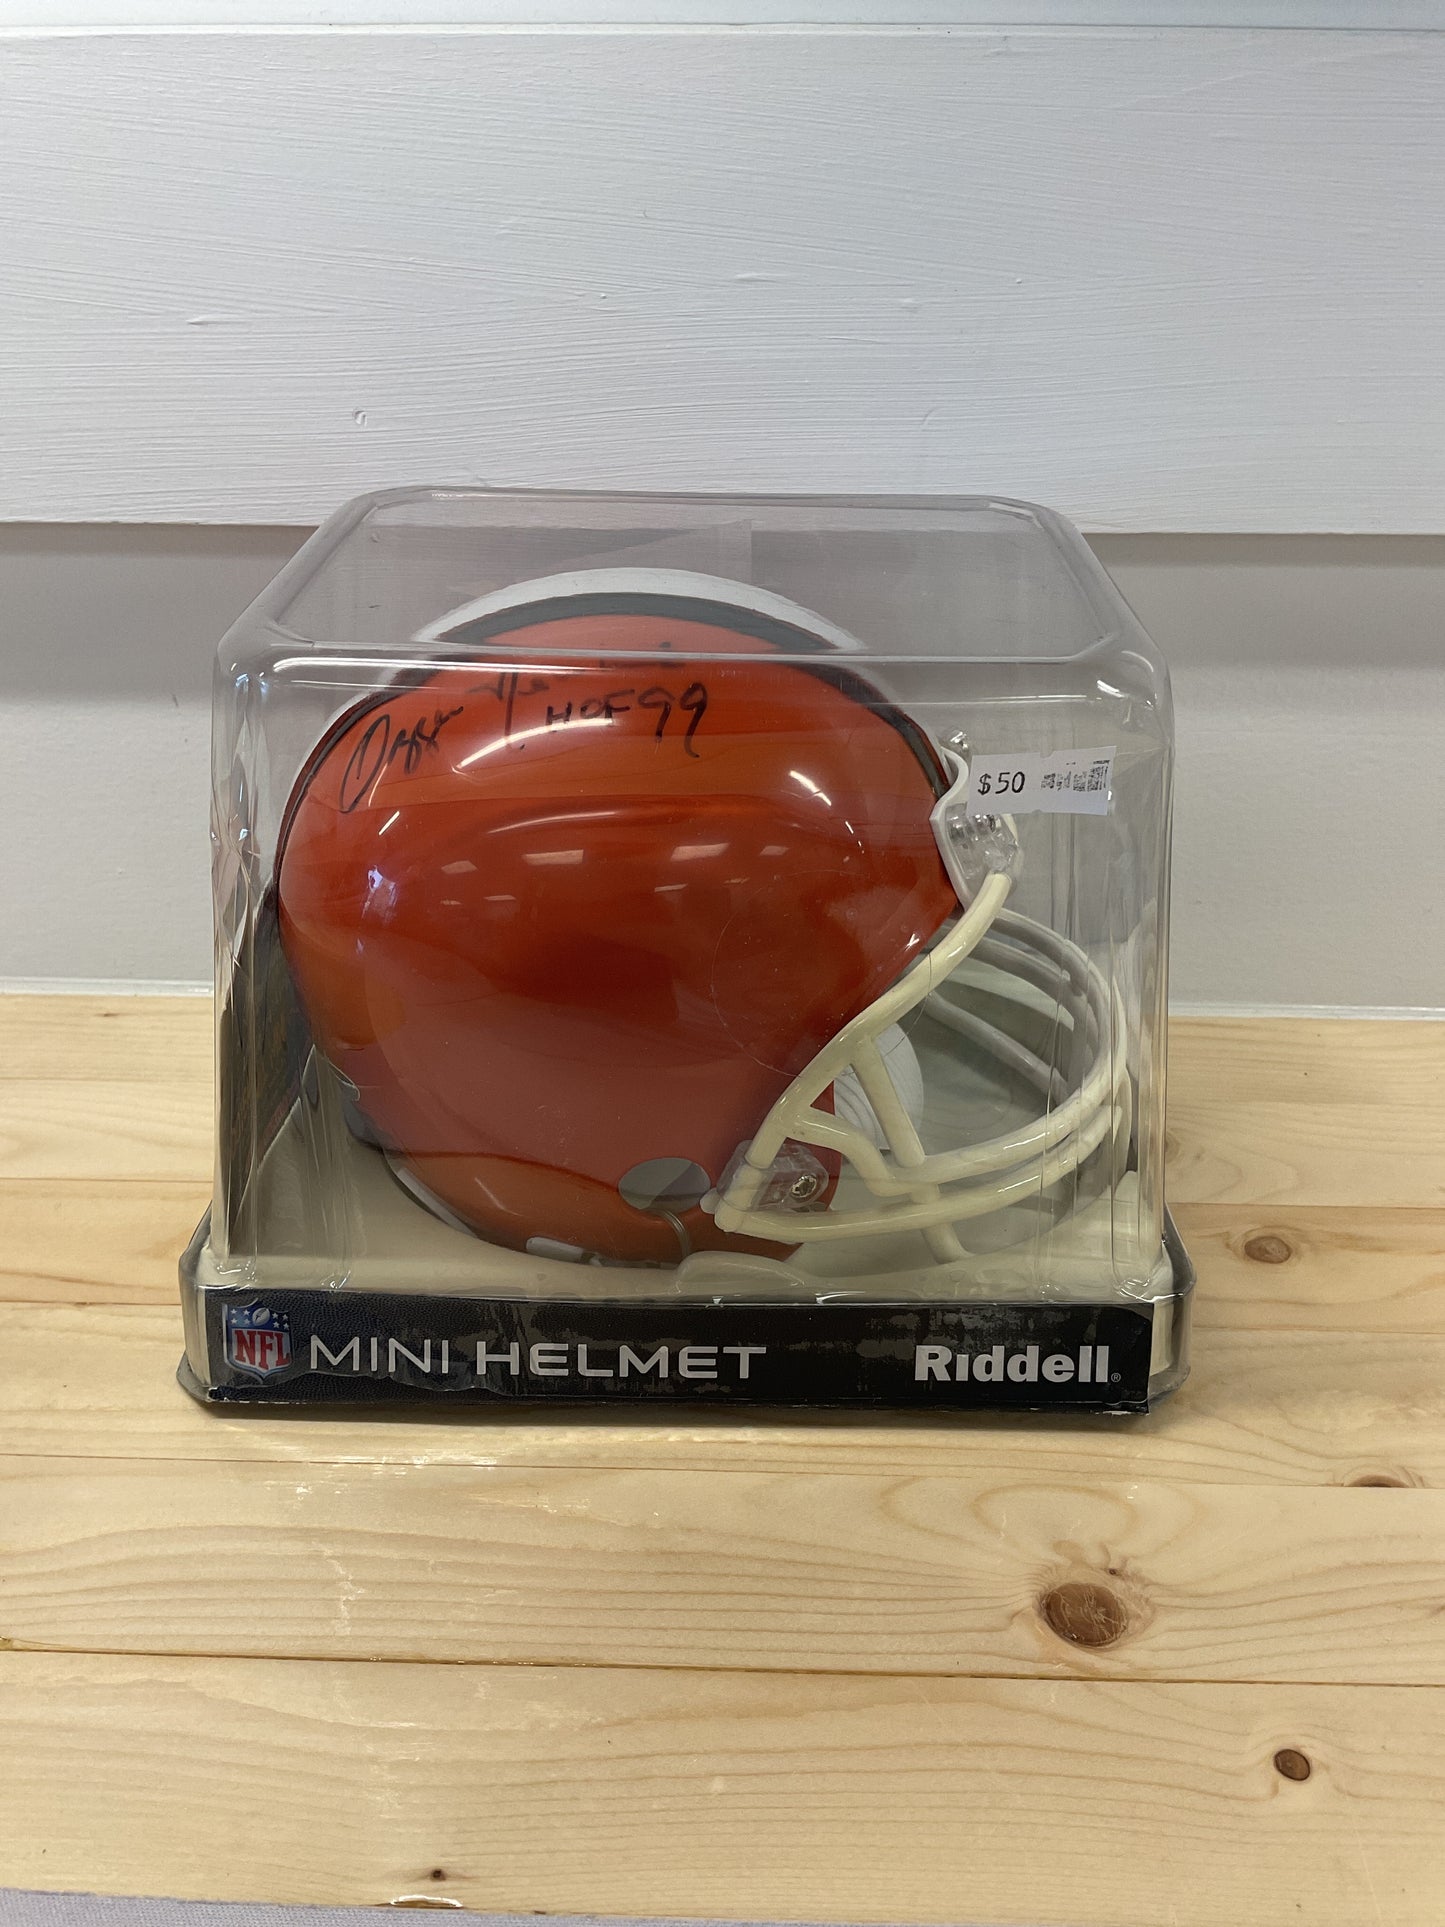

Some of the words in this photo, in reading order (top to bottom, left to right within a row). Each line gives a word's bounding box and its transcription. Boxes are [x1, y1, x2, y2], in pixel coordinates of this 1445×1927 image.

[977, 771, 1026, 796] $50
[234, 1329, 292, 1371] NFL
[310, 1336, 449, 1374] MINI
[475, 1340, 767, 1379] HELMET
